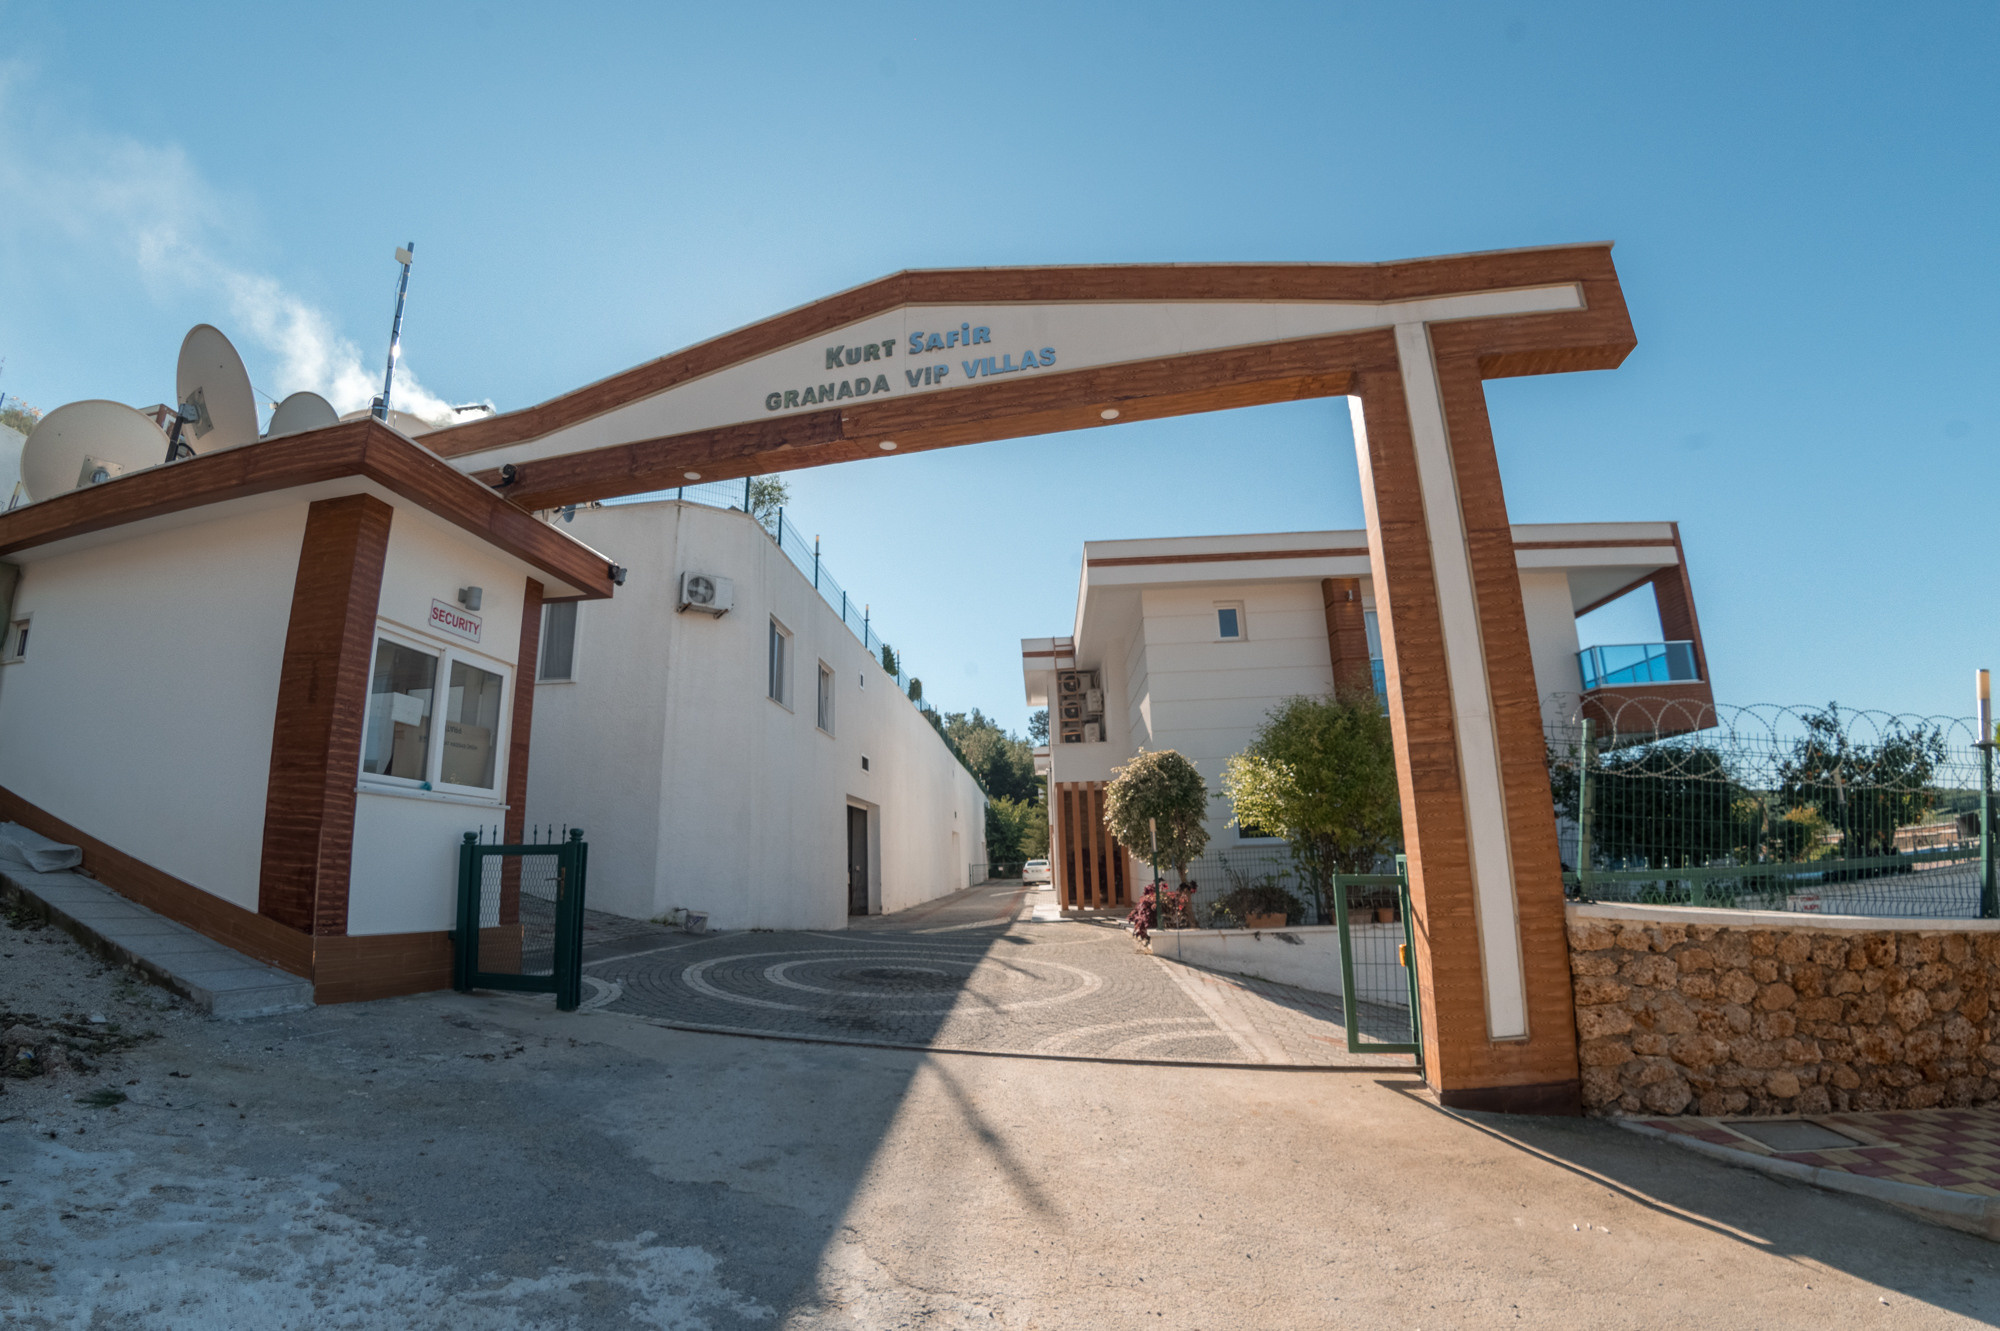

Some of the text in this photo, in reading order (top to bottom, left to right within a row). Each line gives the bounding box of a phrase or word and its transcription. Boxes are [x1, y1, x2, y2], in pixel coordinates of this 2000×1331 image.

[825, 339, 896, 370] KURT
[765, 347, 1057, 411] GRANADA VIP VILLAS
[431, 607, 480, 635] SECURITY
